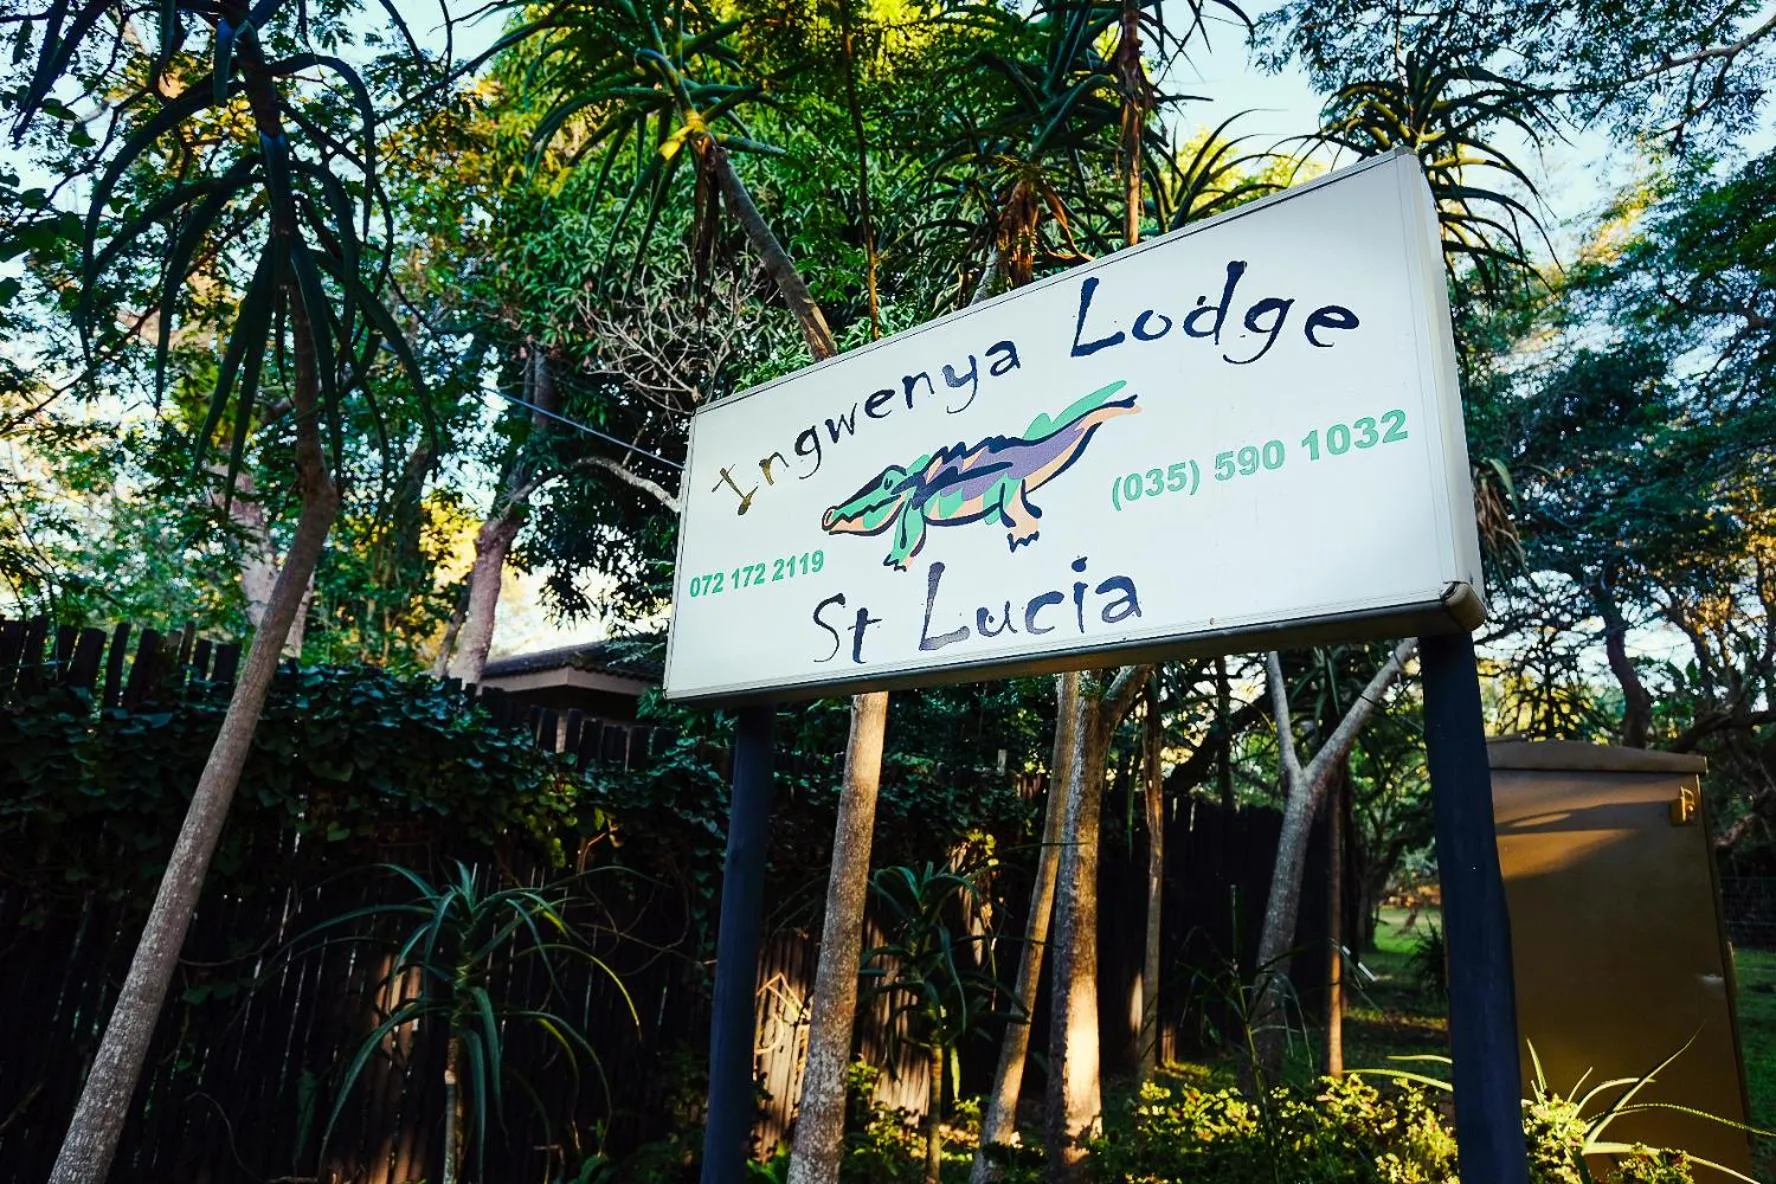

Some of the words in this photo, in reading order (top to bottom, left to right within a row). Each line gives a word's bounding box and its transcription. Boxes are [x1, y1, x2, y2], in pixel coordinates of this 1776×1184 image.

[711, 340, 1021, 516] Ingwenya
[1070, 260, 1360, 364] Lodge
[1112, 459, 1200, 511] (035)
[1214, 440, 1285, 482] 590
[1301, 409, 1408, 461] 1032
[689, 573, 724, 598] 072
[731, 563, 765, 590] 172
[771, 550, 824, 582] 2119
[813, 592, 883, 664] St
[919, 556, 1142, 650] Lucia
